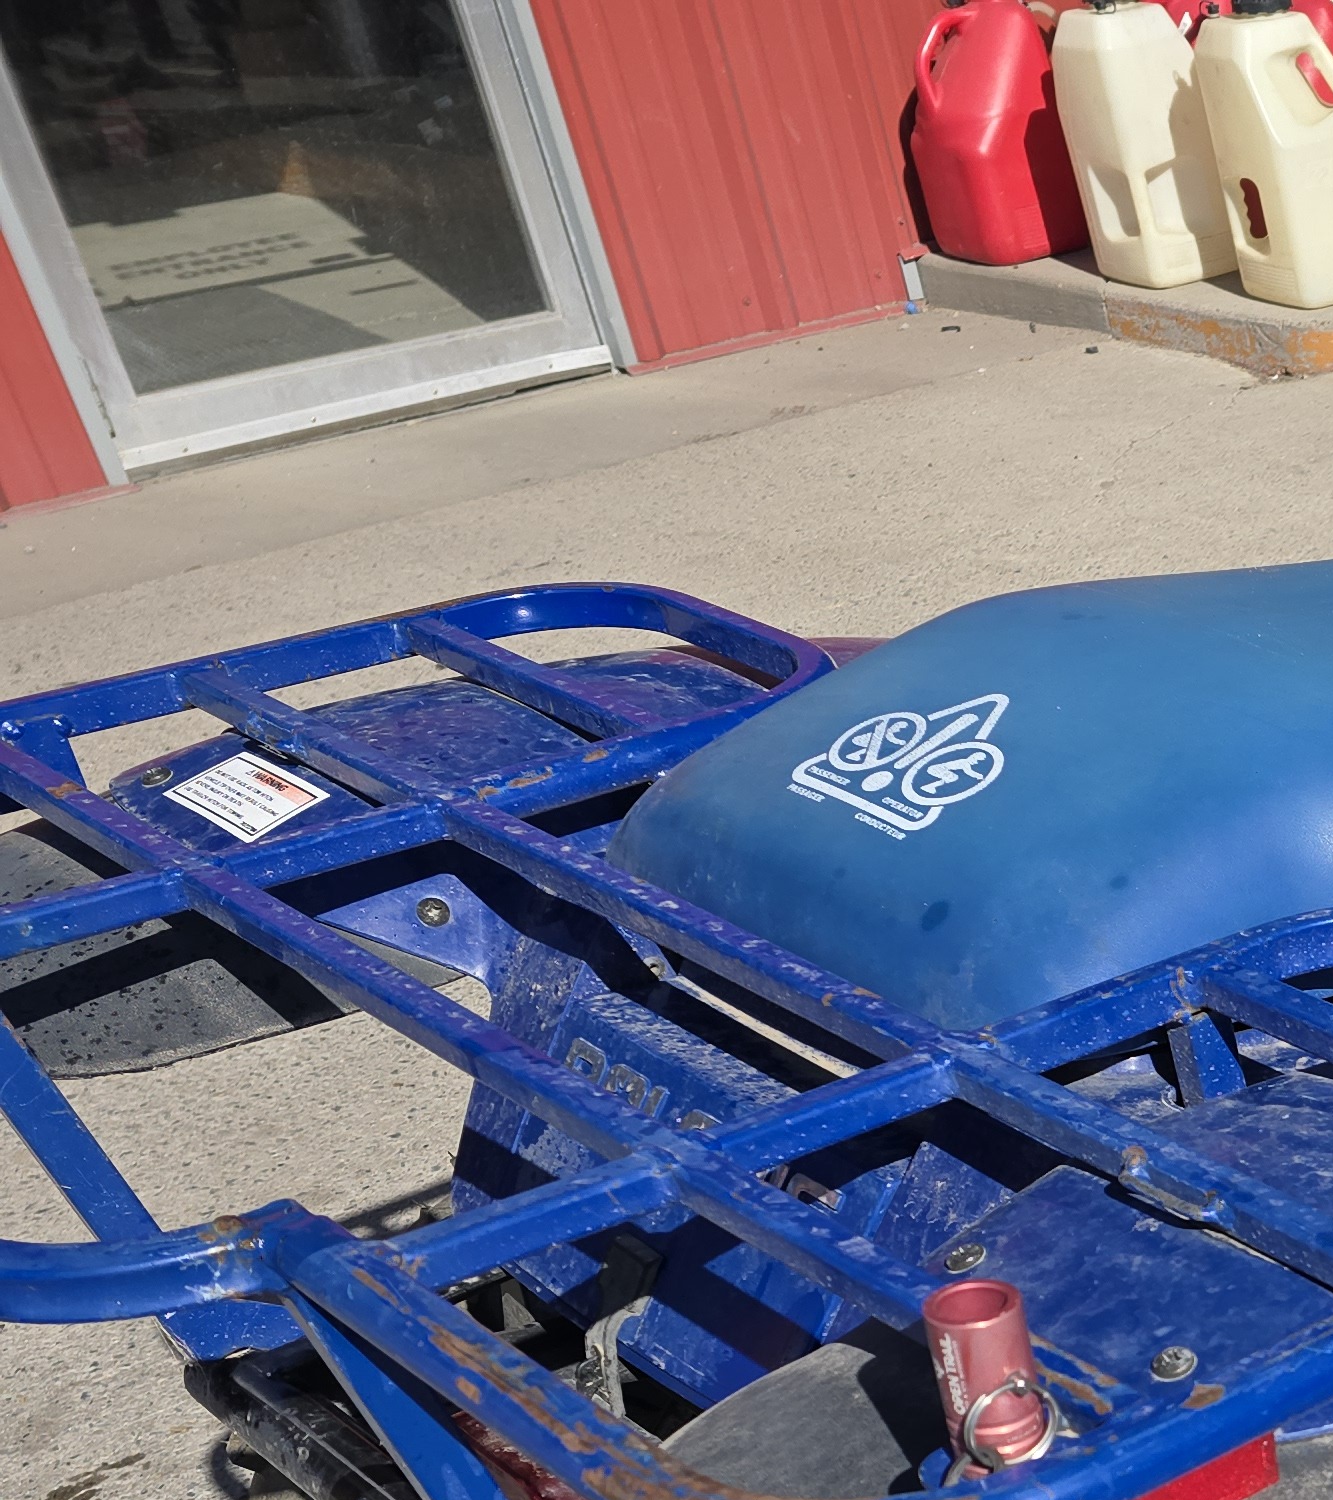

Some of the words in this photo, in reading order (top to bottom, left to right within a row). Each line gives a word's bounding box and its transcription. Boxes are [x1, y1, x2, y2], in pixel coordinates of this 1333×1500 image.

[253, 771, 289, 792] WARNING
[808, 765, 851, 786] PASSENGER
[786, 783, 825, 802] PASSAGER
[881, 797, 923, 819] OPERATOR
[855, 813, 906, 840] CONDUCTEUR
